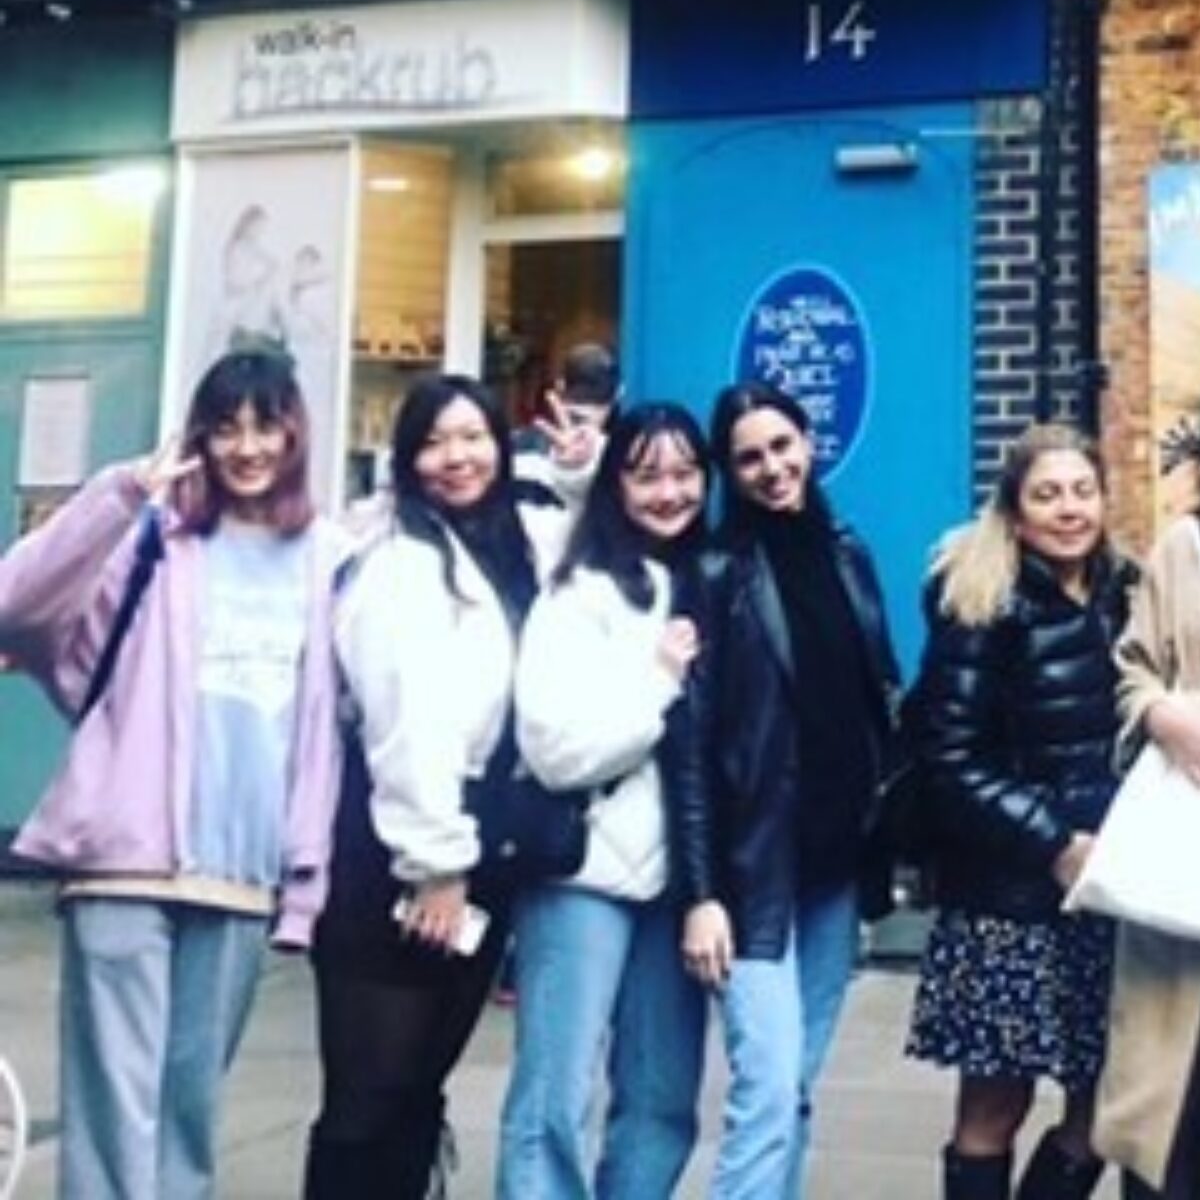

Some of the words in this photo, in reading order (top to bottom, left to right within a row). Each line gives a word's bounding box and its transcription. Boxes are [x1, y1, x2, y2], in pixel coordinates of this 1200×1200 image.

[253, 19, 356, 56] walk-in
[804, 2, 876, 62] 14
[233, 32, 497, 120] backrub
